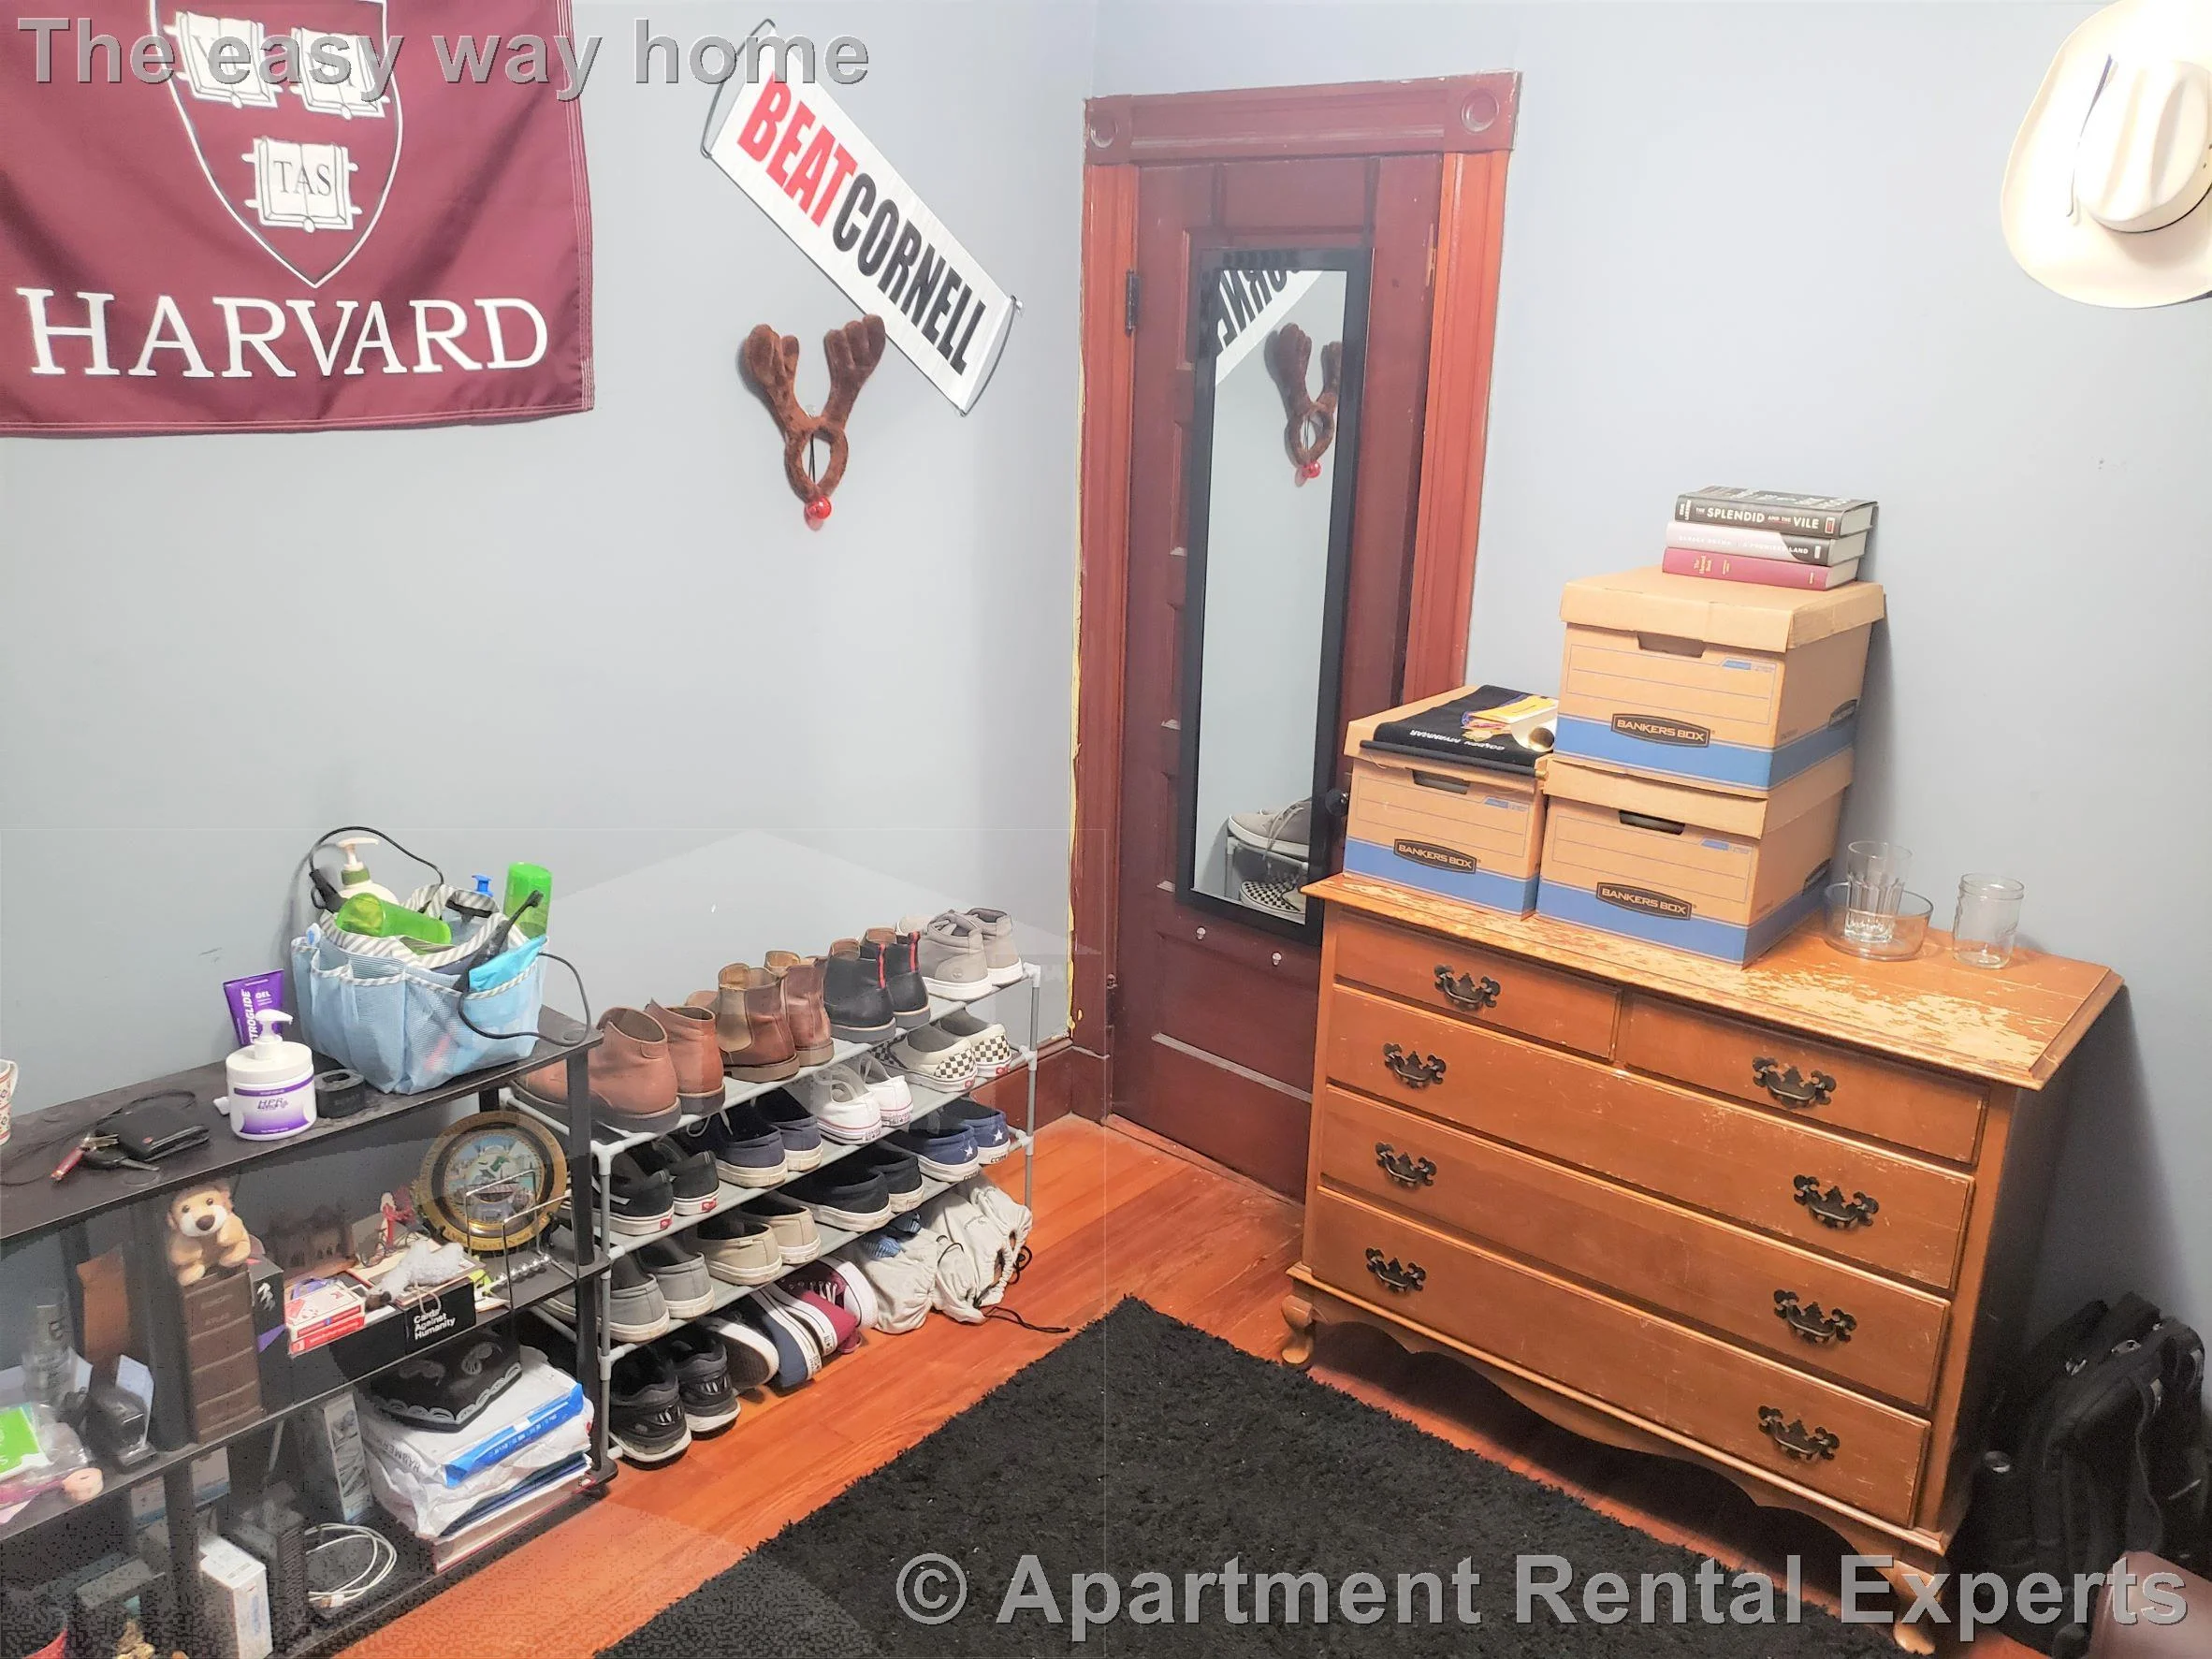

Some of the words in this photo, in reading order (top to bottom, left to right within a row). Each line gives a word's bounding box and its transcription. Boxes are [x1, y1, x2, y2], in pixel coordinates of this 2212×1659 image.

[272, 159, 332, 197] TAS
[736, 71, 858, 228] BEAT
[832, 173, 987, 376] CORNELL
[16, 286, 548, 378] HARVARD
[1695, 507, 1706, 516] THE
[1707, 507, 1766, 523] SPLENDID
[1793, 517, 1820, 530] VILE
[1789, 546, 1809, 555] LAND
[1616, 719, 1676, 736] BANKERS
[1677, 730, 1704, 741] BOX
[1398, 844, 1448, 863] BANKERS
[1448, 856, 1473, 869] BOX
[1601, 887, 1659, 908] BANKERS
[1659, 900, 1687, 915] BOX
[255, 990, 272, 999] GEL
[414, 1308, 441, 1324] Cards
[415, 1312, 447, 1332] Against
[415, 1317, 457, 1341] Humanity
